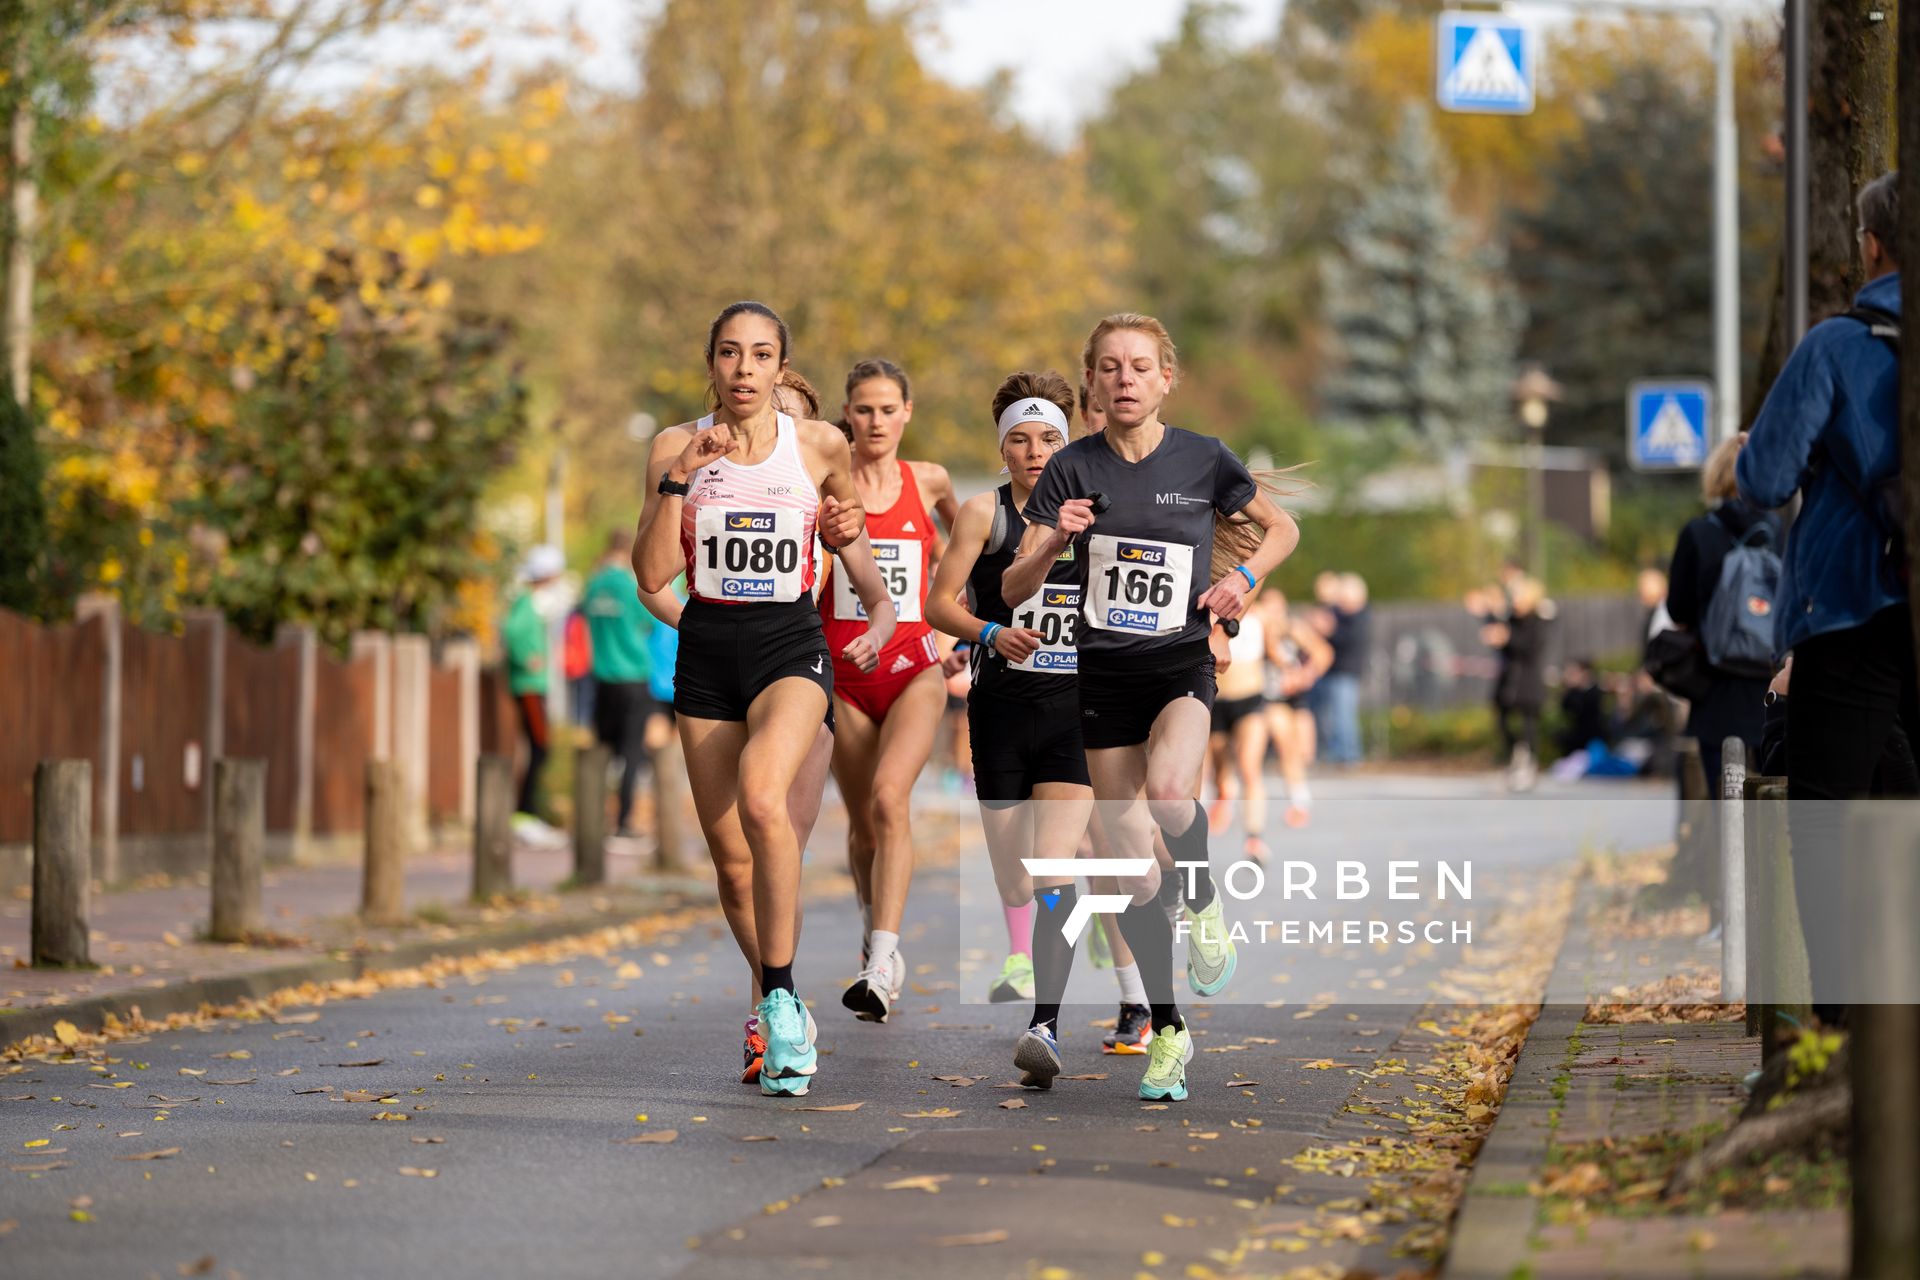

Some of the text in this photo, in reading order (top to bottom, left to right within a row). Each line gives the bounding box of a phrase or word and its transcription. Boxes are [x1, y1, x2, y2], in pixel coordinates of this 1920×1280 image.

[1156, 492, 1182, 505] MIT
[751, 518, 772, 529] GLS
[702, 535, 798, 574] 1080
[1141, 550, 1163, 562] GLS
[743, 581, 773, 591] PLAN
[1104, 566, 1175, 608] 166
[1065, 594, 1080, 605] GLS
[1127, 612, 1157, 625] PLAN
[1053, 654, 1078, 664] PLAN
